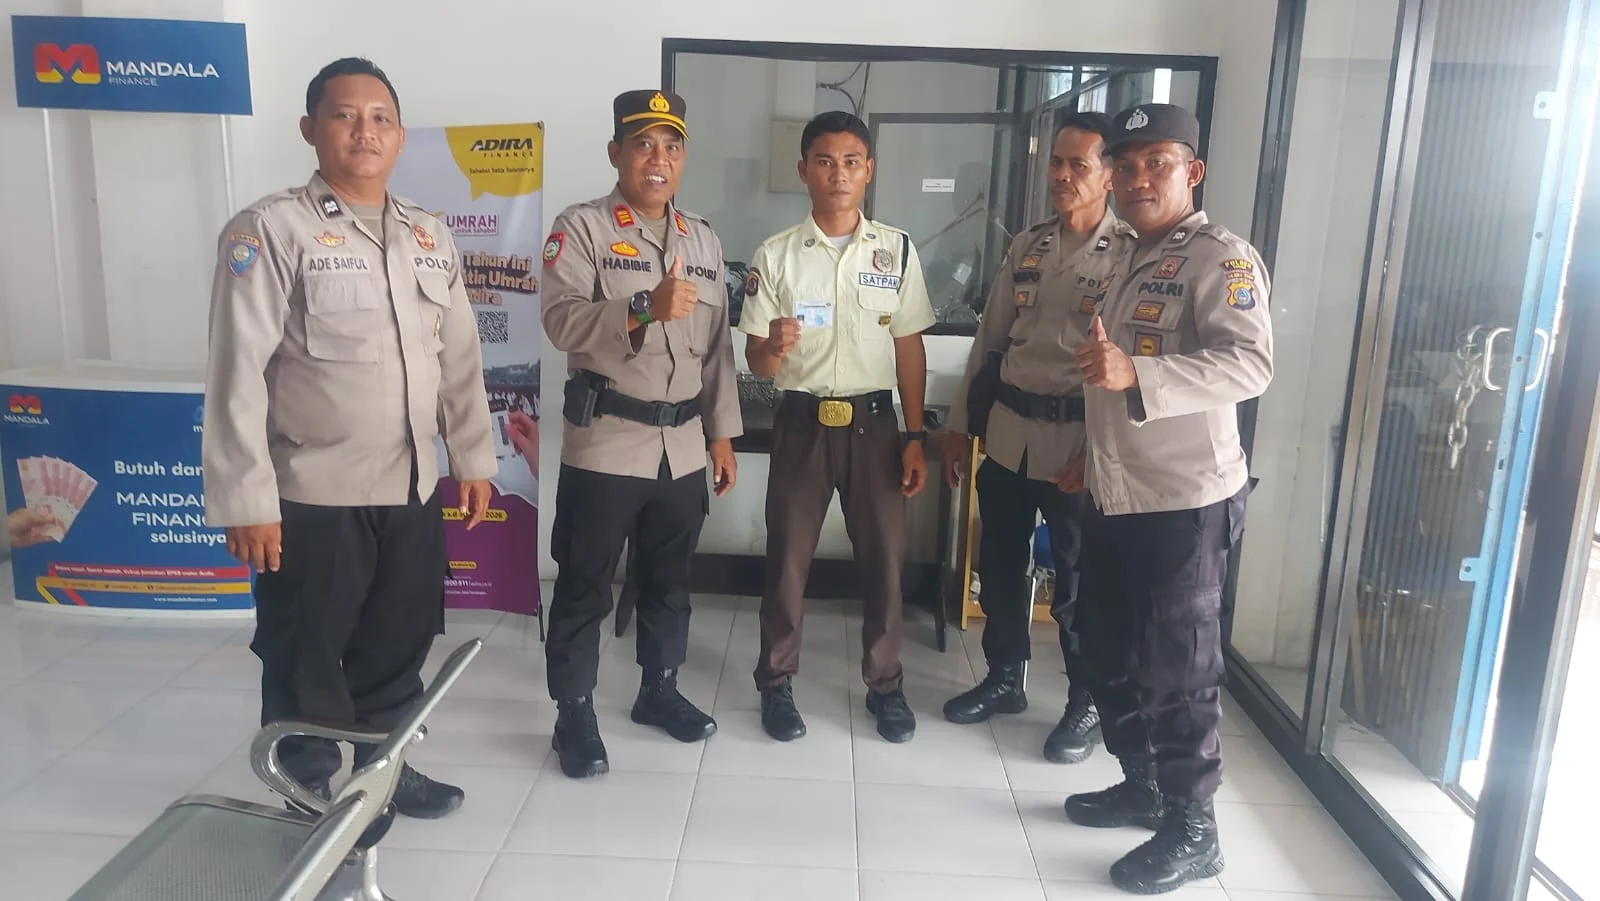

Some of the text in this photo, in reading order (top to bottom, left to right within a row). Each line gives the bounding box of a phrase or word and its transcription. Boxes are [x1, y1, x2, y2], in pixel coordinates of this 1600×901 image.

[106, 60, 220, 78] MANDALA
[109, 77, 158, 86] FINANCE
[470, 138, 533, 152] ADIRA
[446, 215, 497, 228] UMRAH
[309, 256, 369, 271] ADE SAIFUL
[414, 256, 450, 272] POLR
[464, 252, 532, 272] Tahun Ini
[603, 257, 652, 273] HABIBIE
[686, 264, 717, 282] POLRI
[488, 271, 539, 292] Umrah
[1138, 281, 1185, 297] POLRI
[3, 414, 50, 425] MANDALA
[114, 460, 166, 476] Butuh
[150, 529, 227, 547] solusinya
